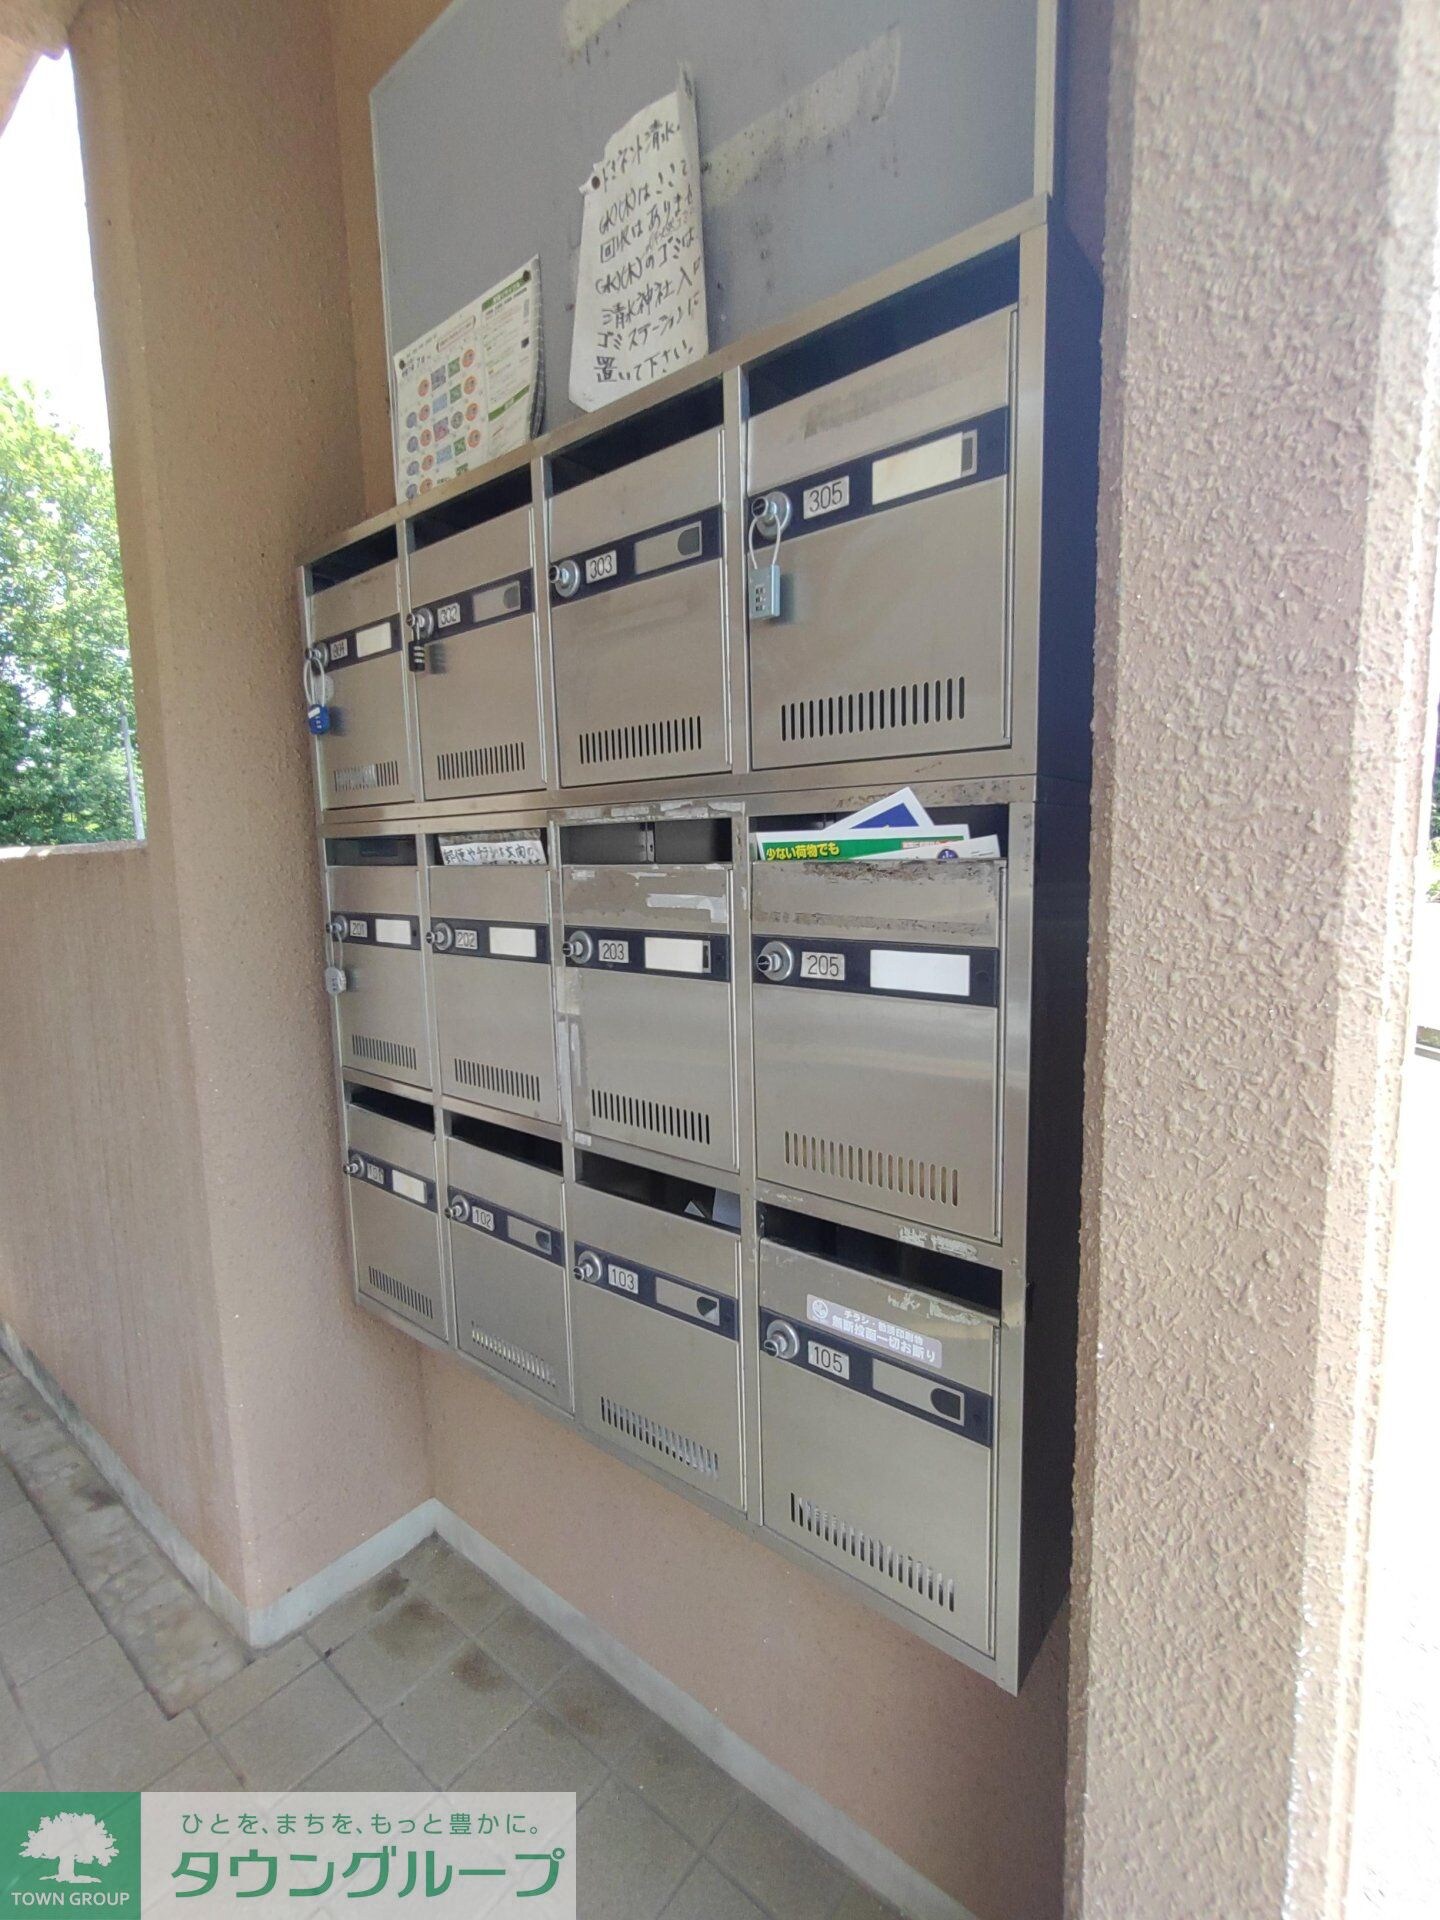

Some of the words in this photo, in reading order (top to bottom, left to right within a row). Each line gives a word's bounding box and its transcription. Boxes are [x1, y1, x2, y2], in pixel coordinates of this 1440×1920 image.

[808, 480, 844, 513] 305
[589, 555, 613, 579] 303
[440, 606, 458, 625] 302
[766, 842, 841, 861] 少ない荷物でも
[457, 931, 476, 948] 202
[602, 942, 625, 961] 203
[806, 954, 839, 977] 205
[474, 1208, 492, 1227] 102
[611, 1268, 635, 1291] 103
[813, 1346, 843, 1373] 105
